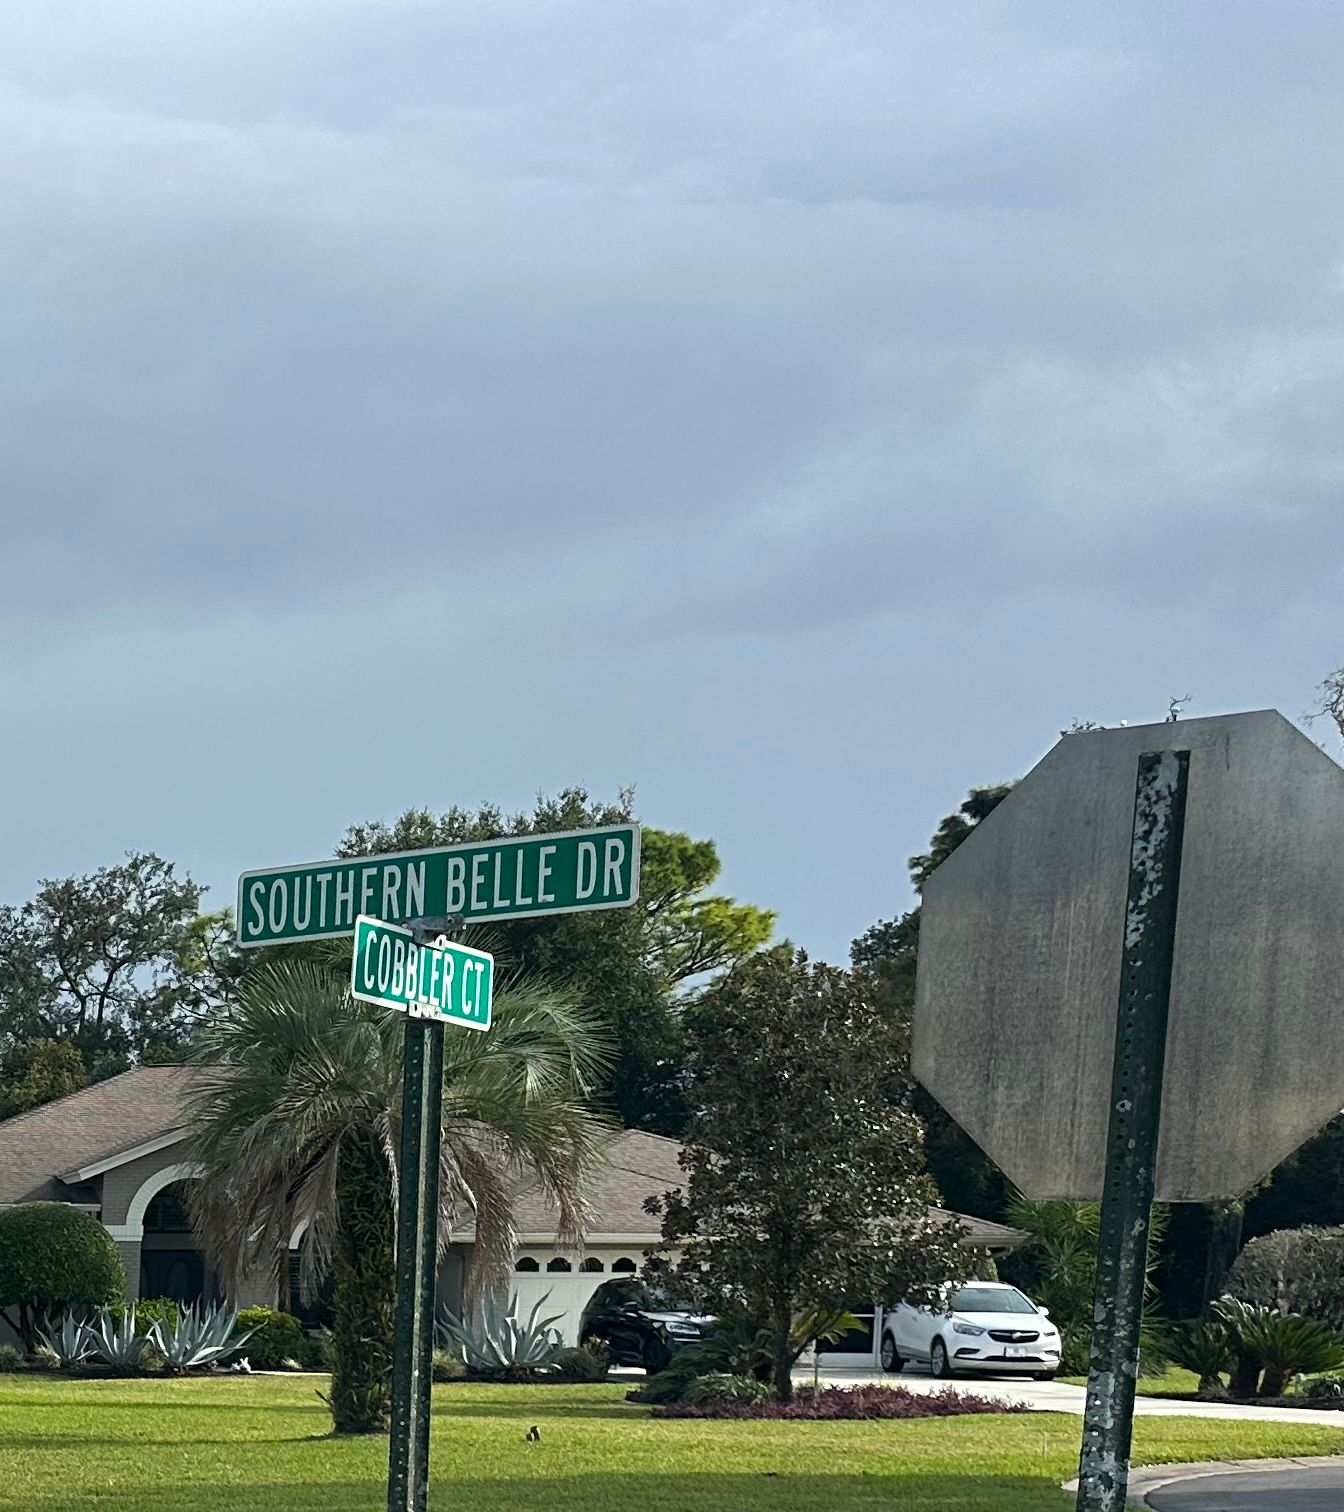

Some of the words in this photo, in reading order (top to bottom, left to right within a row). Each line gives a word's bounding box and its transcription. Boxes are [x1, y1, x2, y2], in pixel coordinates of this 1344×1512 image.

[247, 860, 425, 936] SOUTHERN
[446, 845, 558, 913] BELLE
[576, 838, 625, 899] DR
[363, 930, 455, 1010] COBBLER
[462, 958, 485, 1017] CT
